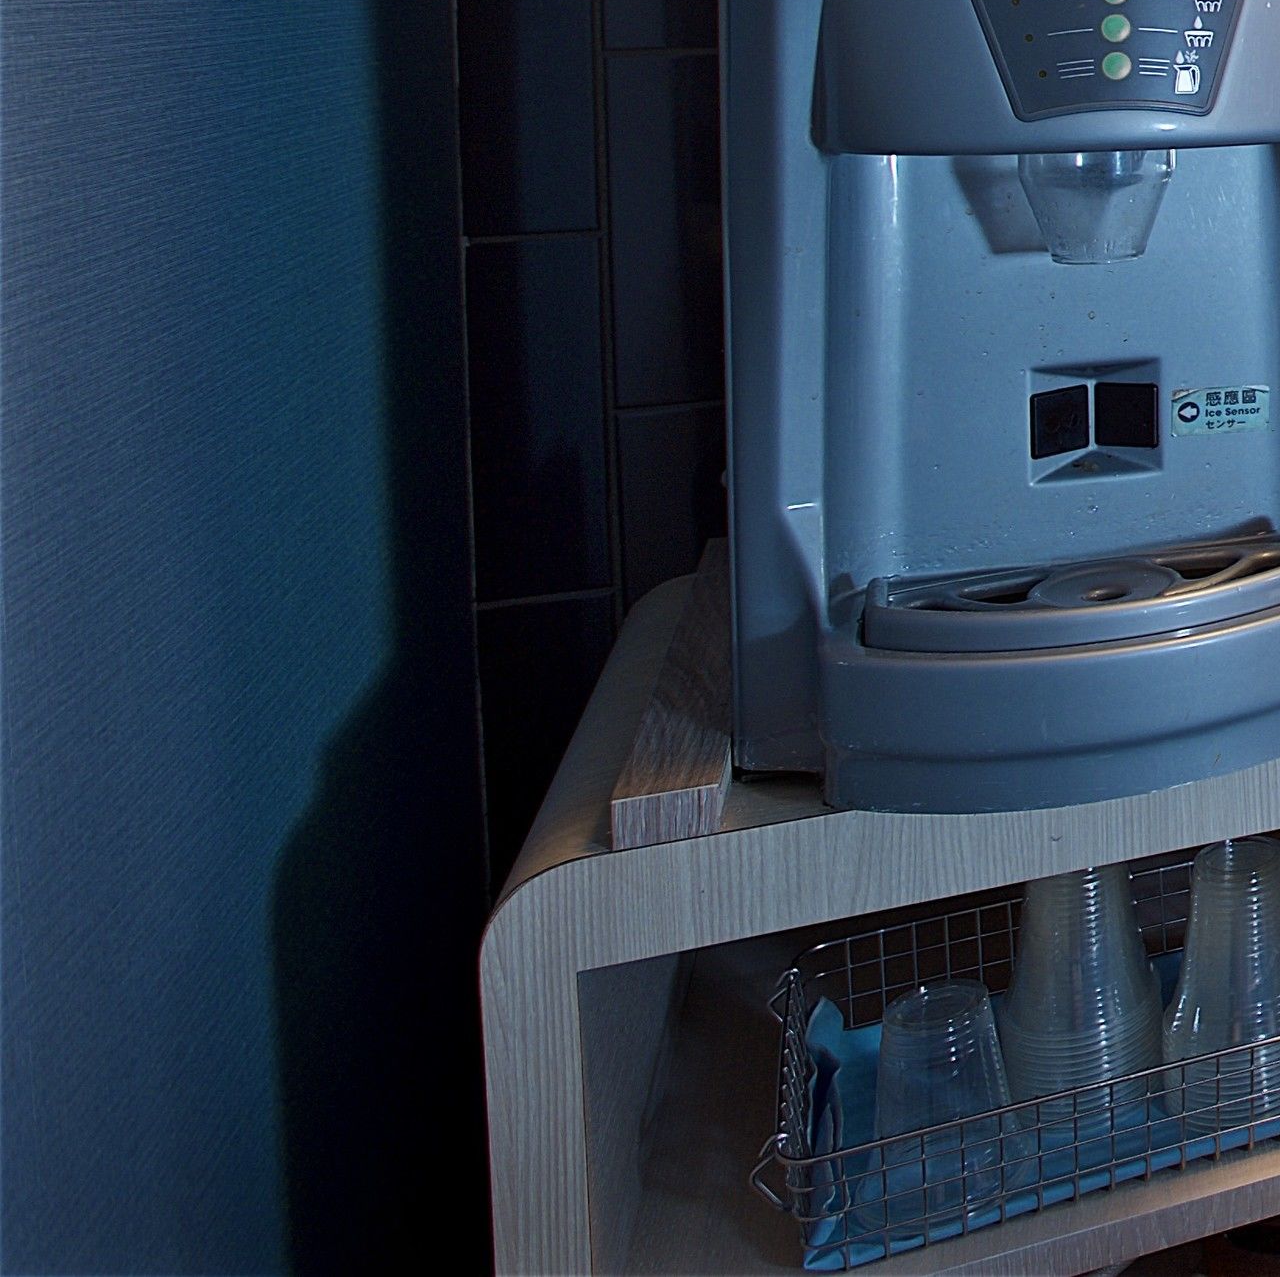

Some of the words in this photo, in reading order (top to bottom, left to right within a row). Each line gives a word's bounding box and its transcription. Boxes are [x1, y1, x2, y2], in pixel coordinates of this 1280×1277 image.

[1205, 390, 1257, 407] 感應區
[1205, 409, 1222, 418] Ice
[1225, 406, 1261, 417] Sensor
[1205, 419, 1246, 430] センサー
